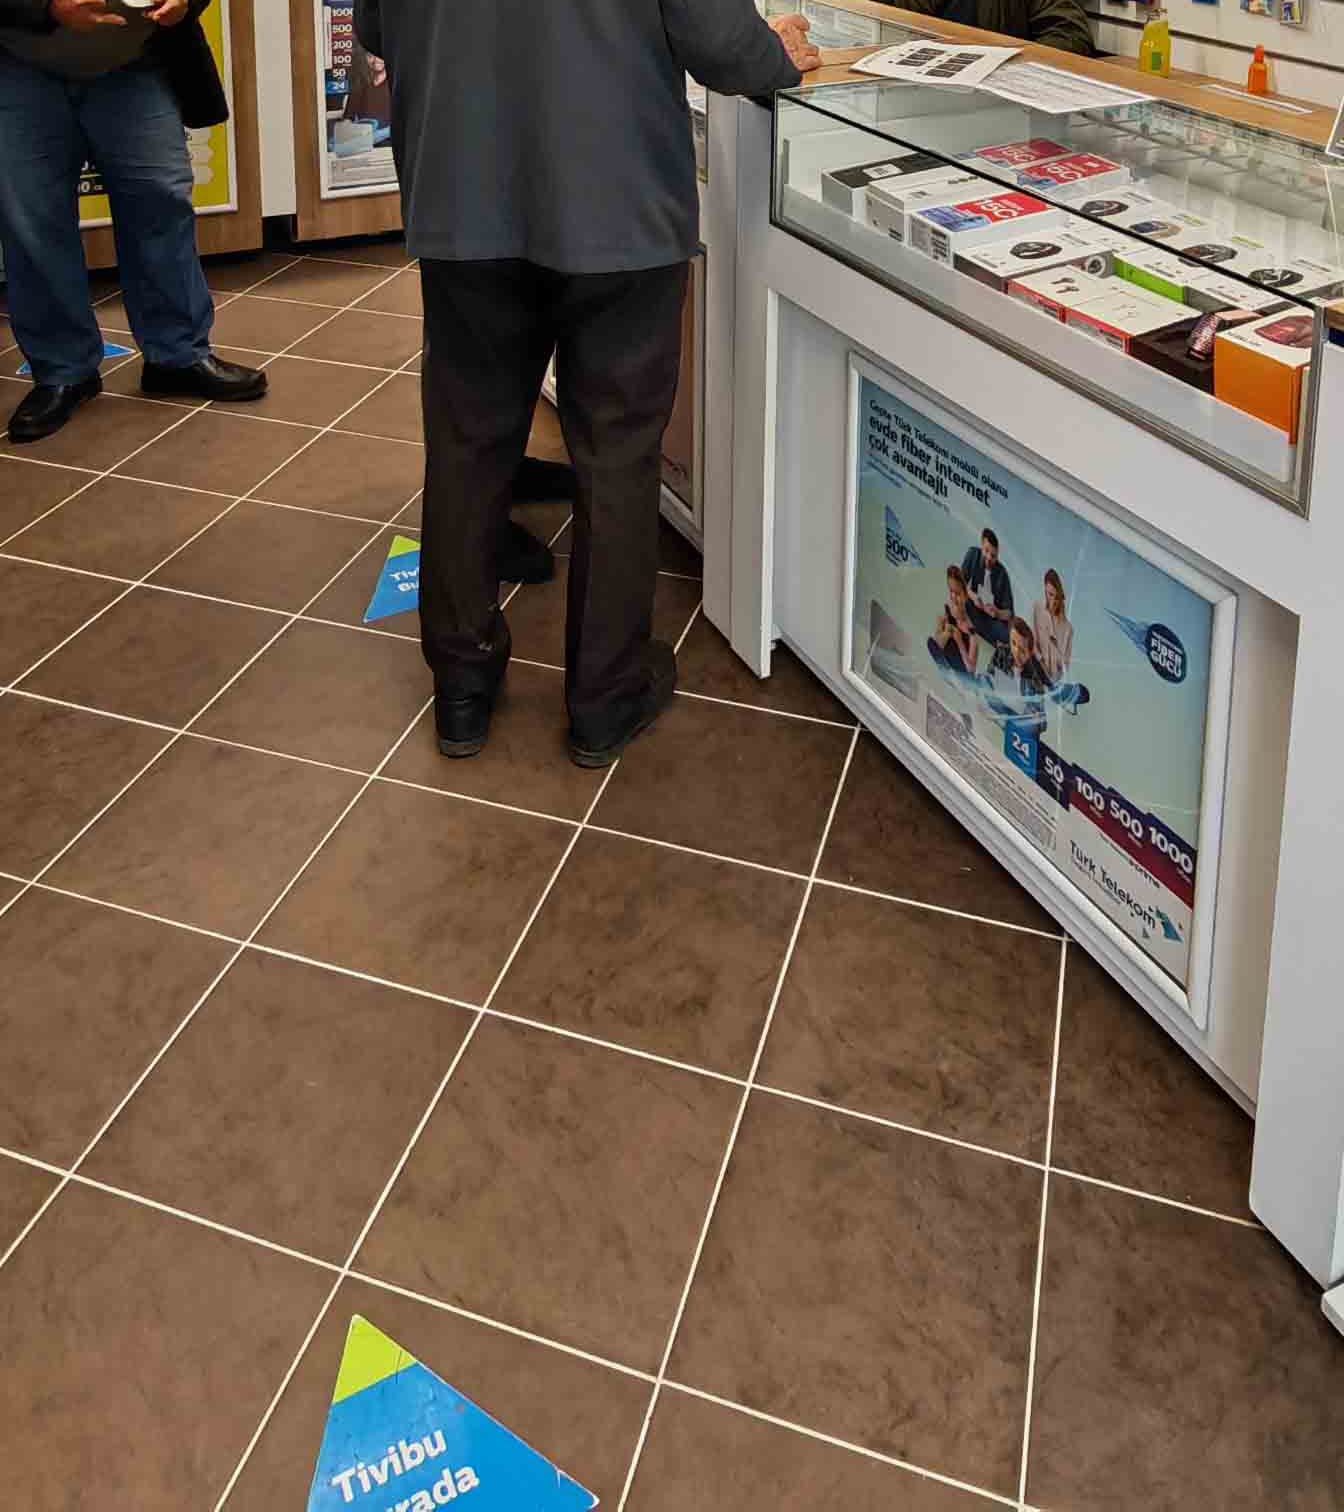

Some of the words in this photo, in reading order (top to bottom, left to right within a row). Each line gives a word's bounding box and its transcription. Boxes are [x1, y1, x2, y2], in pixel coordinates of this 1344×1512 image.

[333, 54, 352, 64] 100
[333, 68, 346, 78] 50
[868, 434, 889, 458] çok
[892, 450, 949, 498] avantajlı
[869, 416, 897, 442] evde
[901, 432, 932, 466] fiber
[935, 458, 991, 508] internet
[1012, 732, 1030, 760] 24
[1044, 756, 1065, 784] 50
[1074, 775, 1106, 811] 100
[1110, 800, 1144, 839] 500
[1149, 826, 1194, 874] 1000
[1069, 839, 1097, 873] Türk
[1100, 868, 1156, 929] Telekom
[331, 1429, 448, 1504] Tivibu
